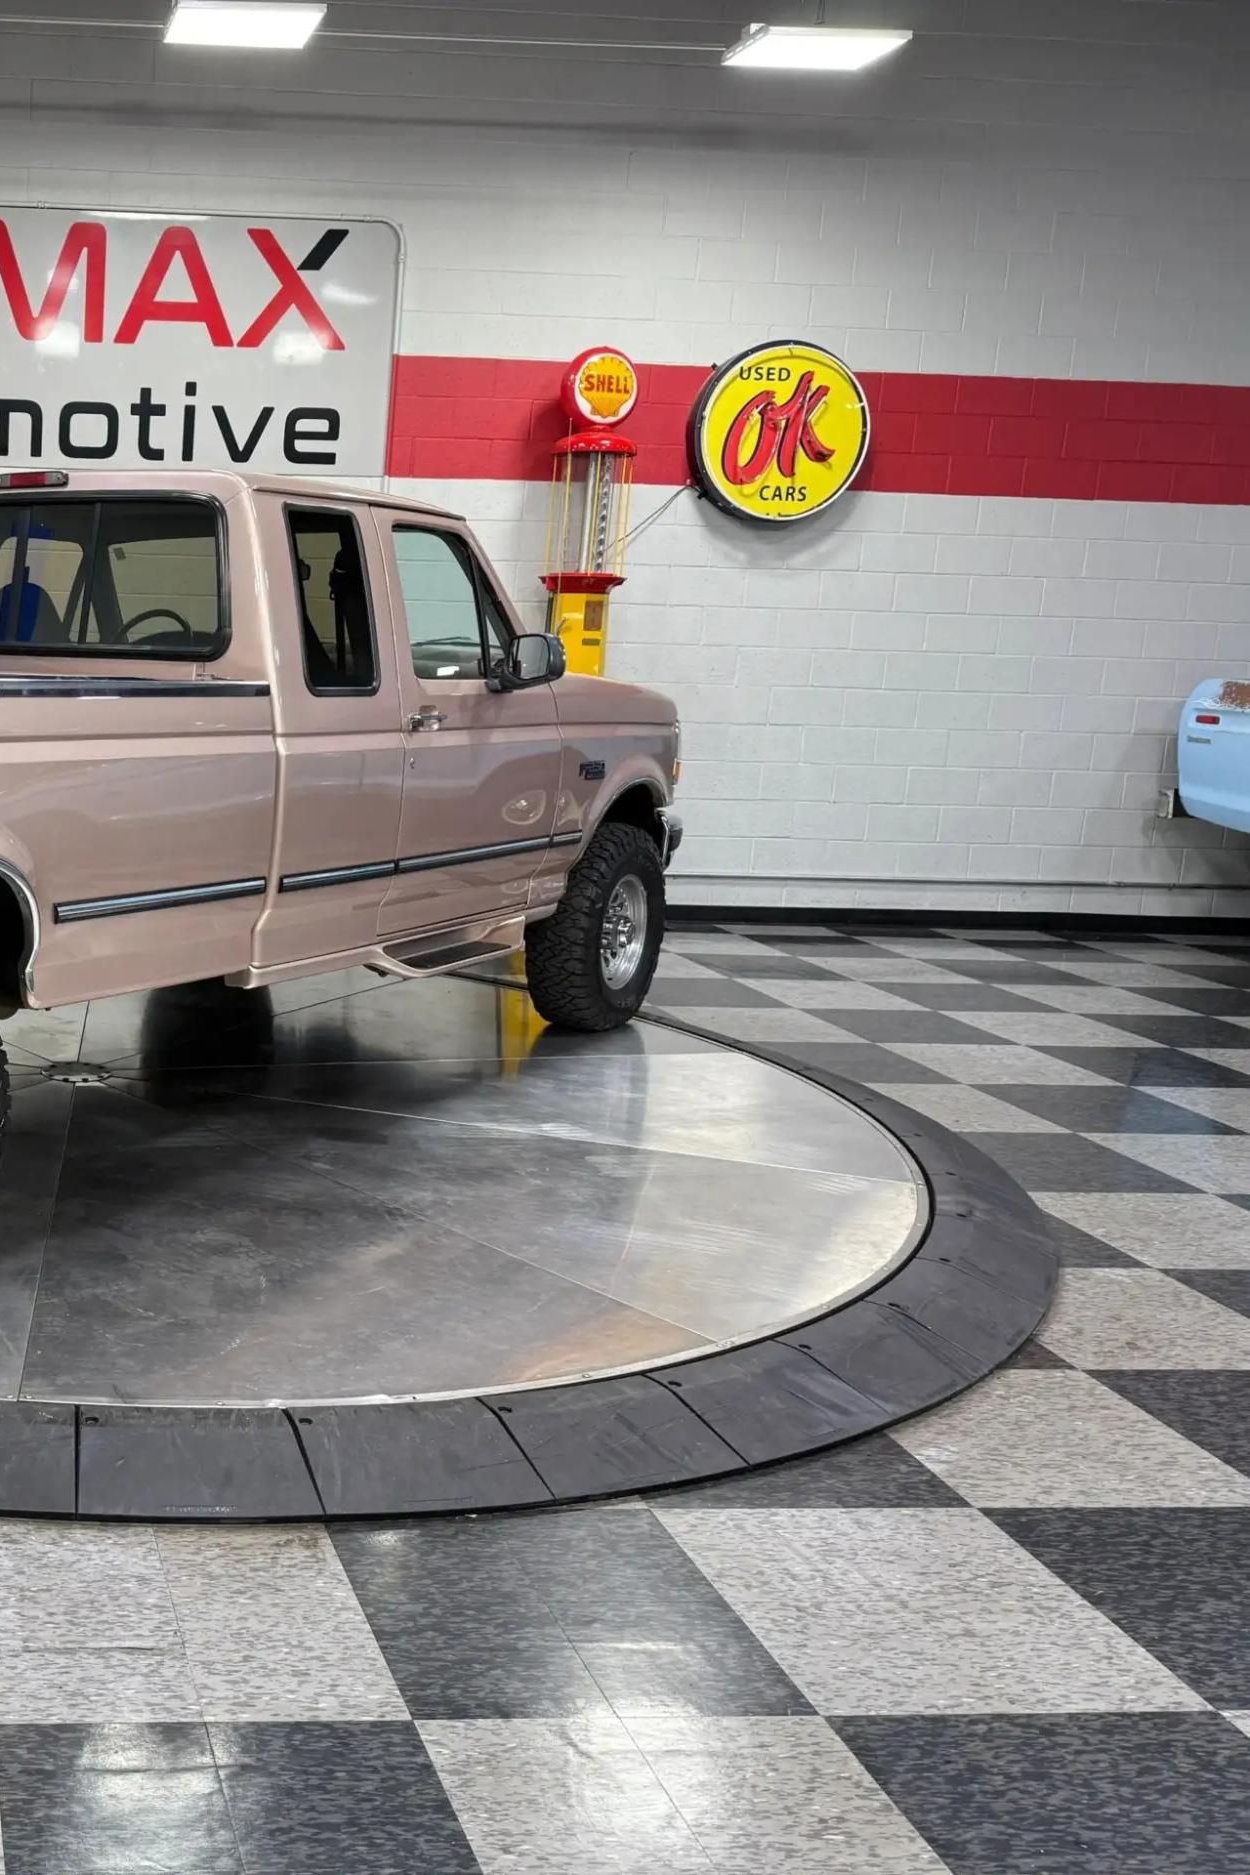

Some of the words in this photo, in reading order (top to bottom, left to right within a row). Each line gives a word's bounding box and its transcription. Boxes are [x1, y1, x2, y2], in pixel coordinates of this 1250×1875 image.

[739, 366, 791, 381] USED
[583, 373, 630, 395] SHELL
[721, 370, 836, 486] OK
[759, 485, 807, 502] CARS
